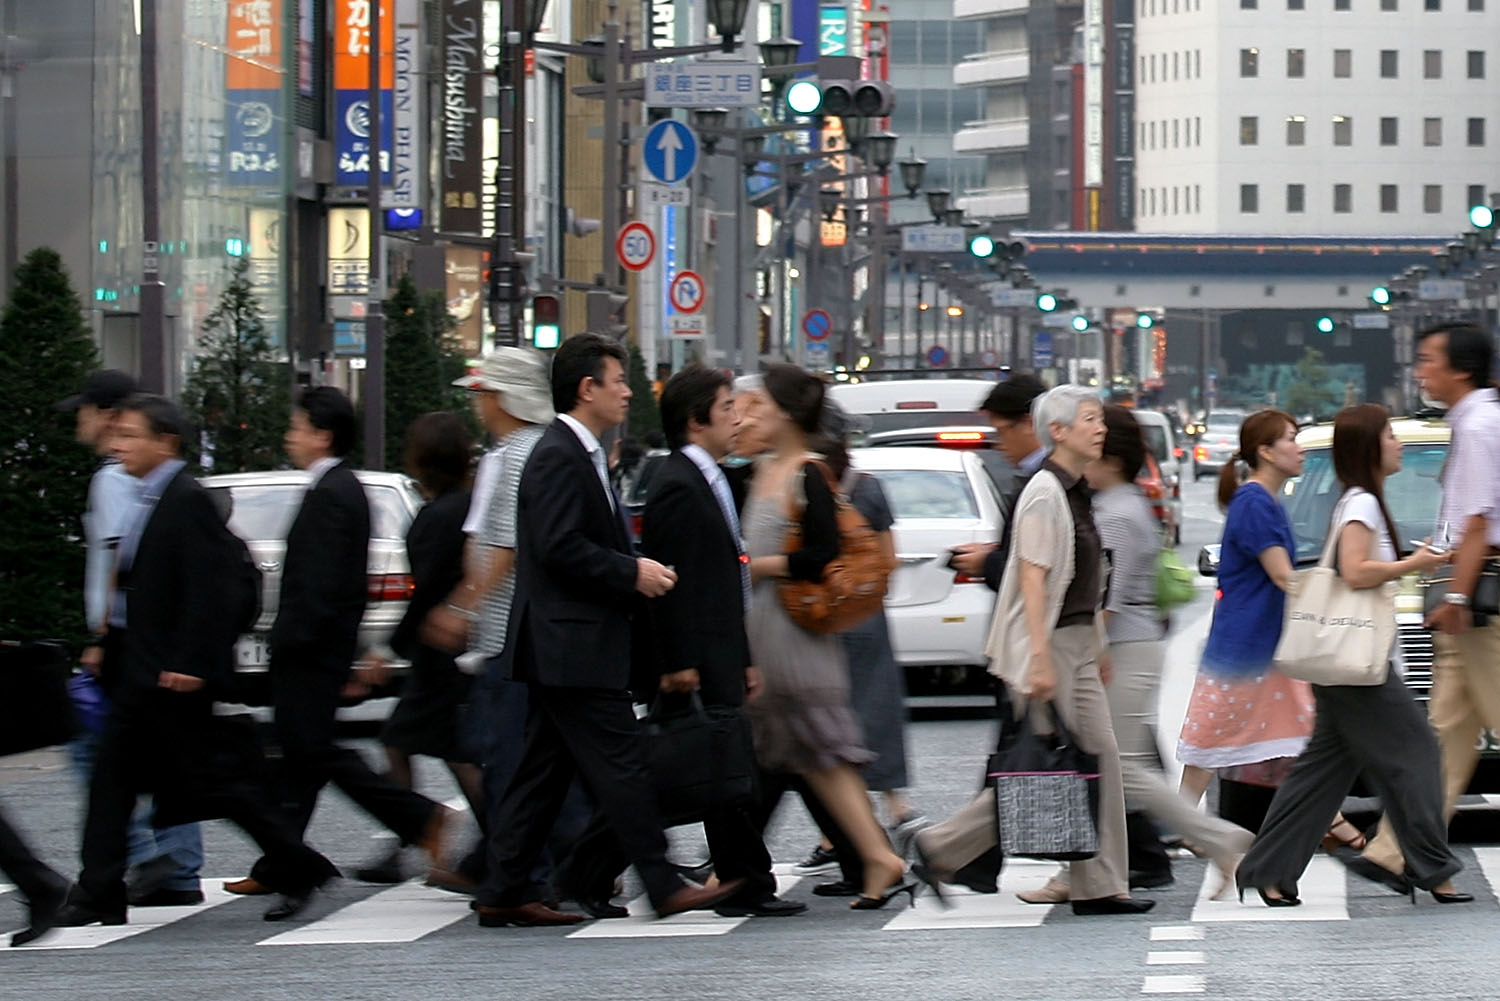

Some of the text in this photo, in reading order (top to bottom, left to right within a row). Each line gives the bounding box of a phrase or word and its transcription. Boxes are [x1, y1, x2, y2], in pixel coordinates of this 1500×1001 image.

[395, 36, 411, 204] MOON PHASE
[443, 15, 477, 180] Matsushima
[655, 74, 753, 92] 銀座三丁目
[625, 235, 648, 258] 50
